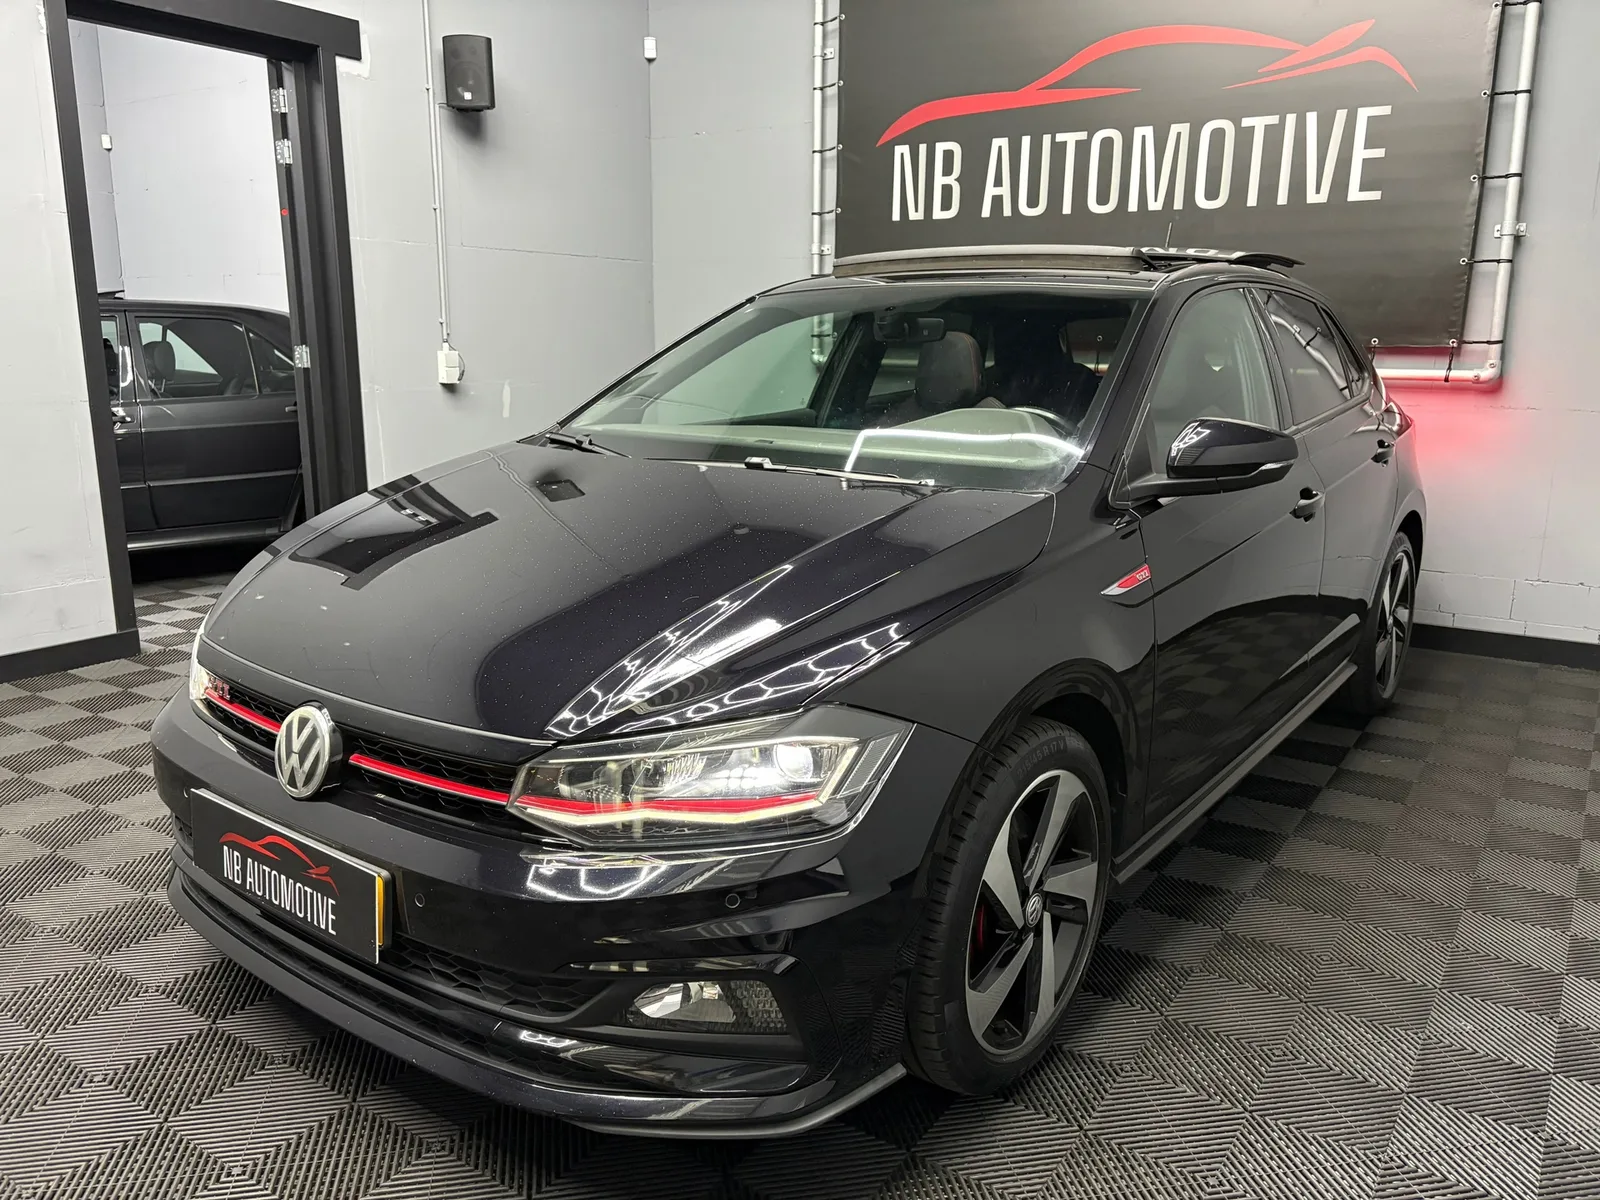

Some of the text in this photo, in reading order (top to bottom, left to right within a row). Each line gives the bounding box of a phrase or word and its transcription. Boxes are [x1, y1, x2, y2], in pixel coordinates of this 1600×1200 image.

[891, 104, 1393, 222] NB AUTOMOTIVE
[223, 845, 337, 936] NB AUTOMOTIVE
